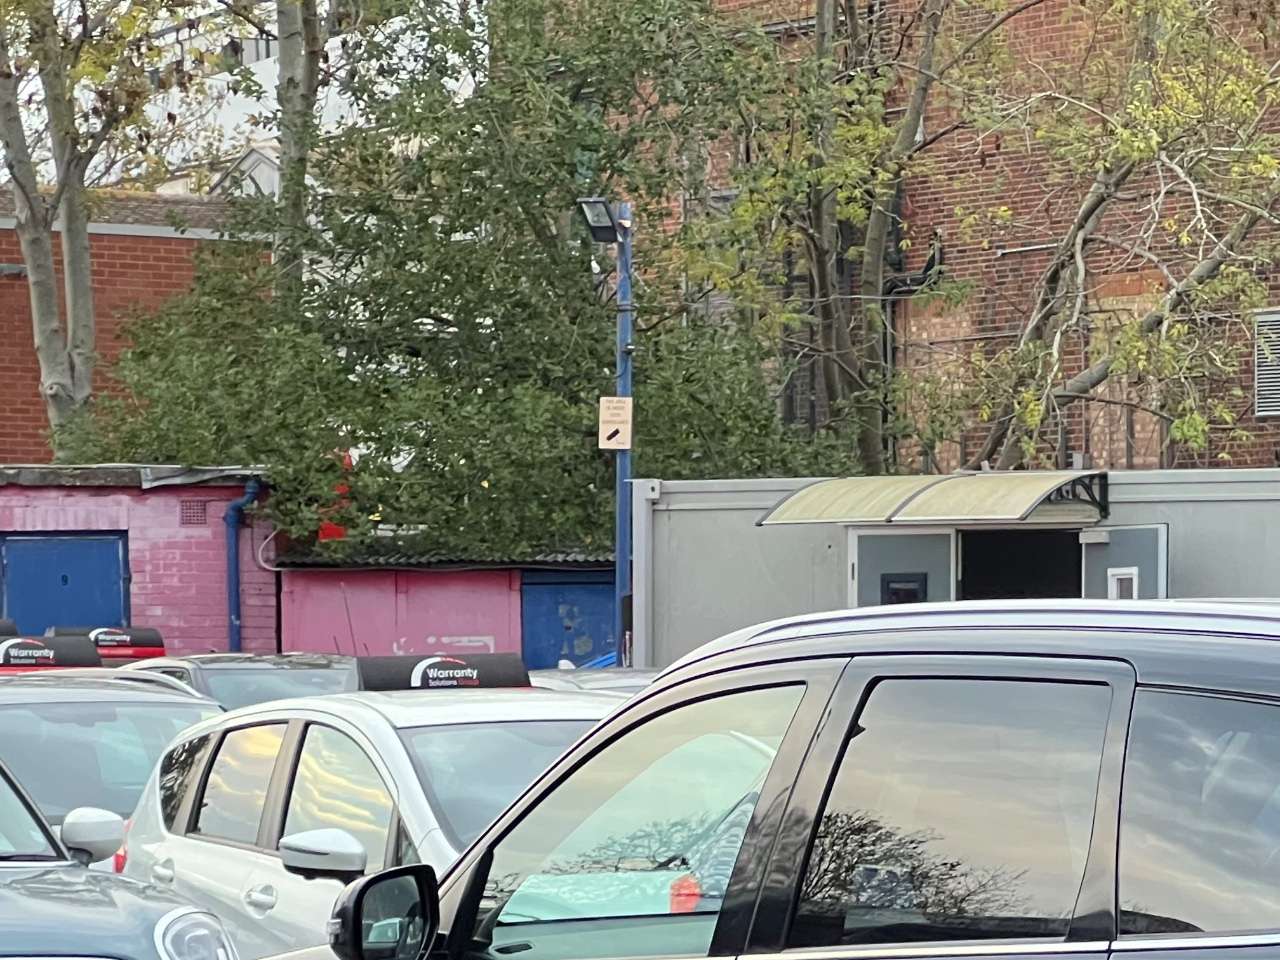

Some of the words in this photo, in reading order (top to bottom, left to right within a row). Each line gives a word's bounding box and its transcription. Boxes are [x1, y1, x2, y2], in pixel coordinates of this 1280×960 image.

[8, 647, 55, 660] Warranty
[426, 667, 478, 680] Warranty
[428, 679, 458, 687] Solutions
